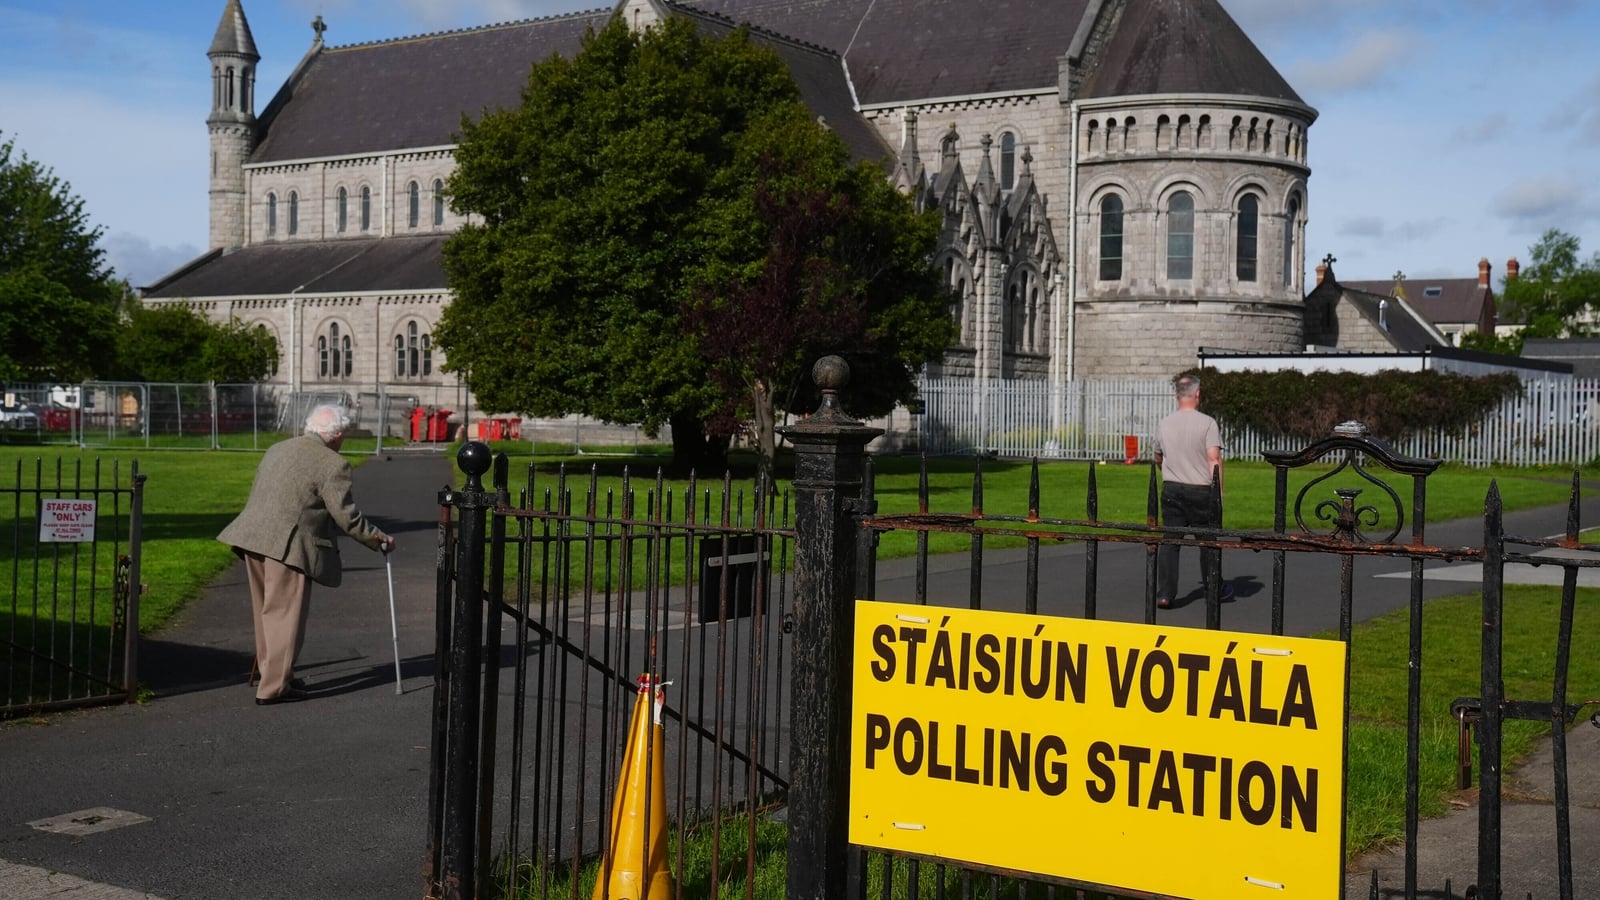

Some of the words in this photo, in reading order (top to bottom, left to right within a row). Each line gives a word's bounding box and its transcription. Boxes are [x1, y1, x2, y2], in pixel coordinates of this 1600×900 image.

[46, 503, 71, 511] STAFF
[73, 503, 93, 511] CARS
[56, 513, 80, 521] ONLY
[871, 616, 1088, 704] STÁISIÚN
[1106, 635, 1318, 730] VÓTÁLA
[866, 713, 1068, 796] POLLING
[1086, 741, 1318, 833] STATION
